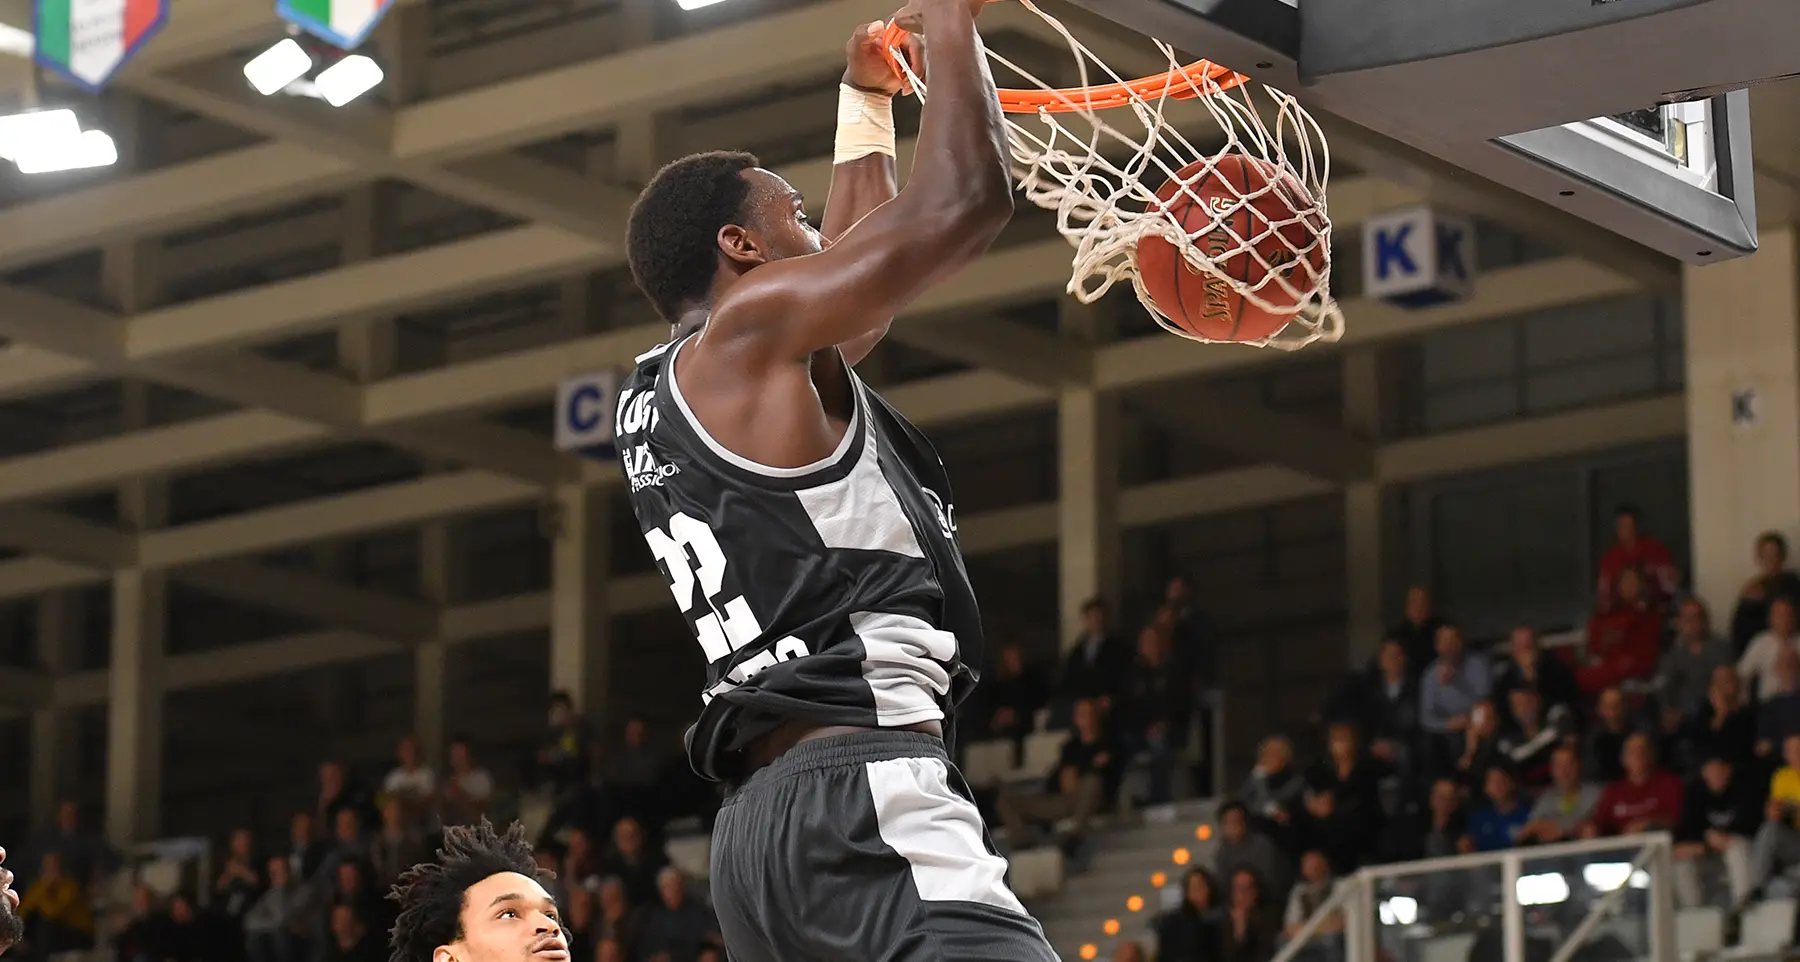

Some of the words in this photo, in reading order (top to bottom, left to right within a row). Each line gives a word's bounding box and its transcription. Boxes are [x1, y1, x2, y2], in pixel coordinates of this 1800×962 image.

[1200, 196, 1238, 321] SPADIG
[1375, 224, 1416, 281] K
[1437, 221, 1468, 282] K
[567, 384, 603, 434] C
[1731, 387, 1757, 425] K
[644, 511, 763, 665] 22
